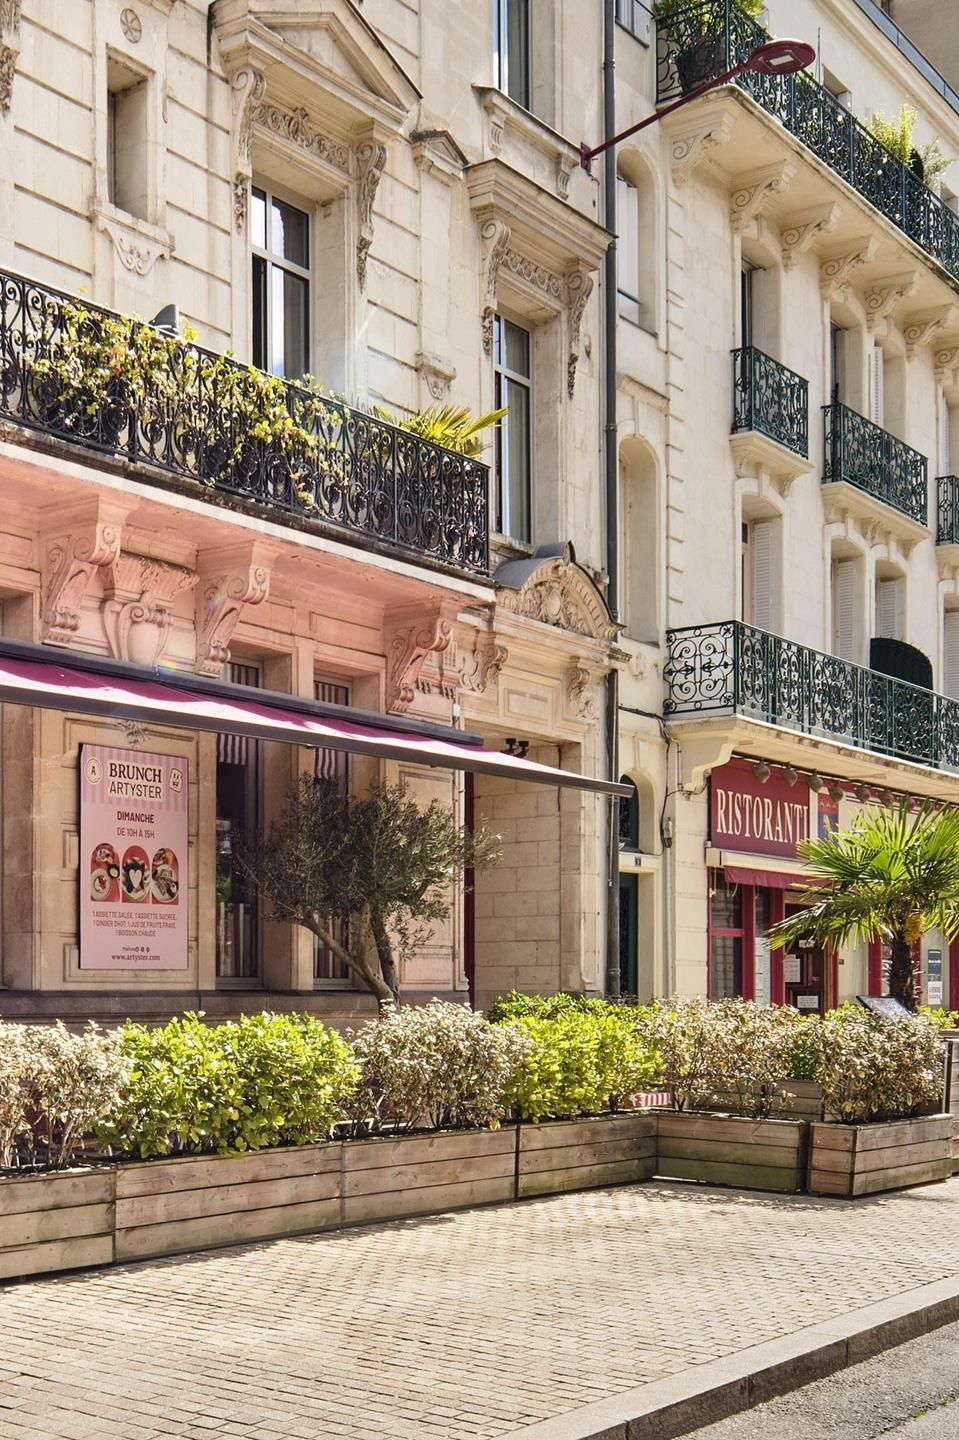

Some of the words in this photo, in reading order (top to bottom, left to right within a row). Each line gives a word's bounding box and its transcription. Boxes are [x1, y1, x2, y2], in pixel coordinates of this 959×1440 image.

[109, 762, 162, 783] BRUNCH
[109, 781, 162, 799] ARTYSTER
[117, 811, 155, 824] DIMANCHE
[116, 827, 125, 837] DE
[126, 828, 138, 838] 10H
[144, 830, 155, 839] 15H
[111, 954, 160, 962] www.artyster.com
